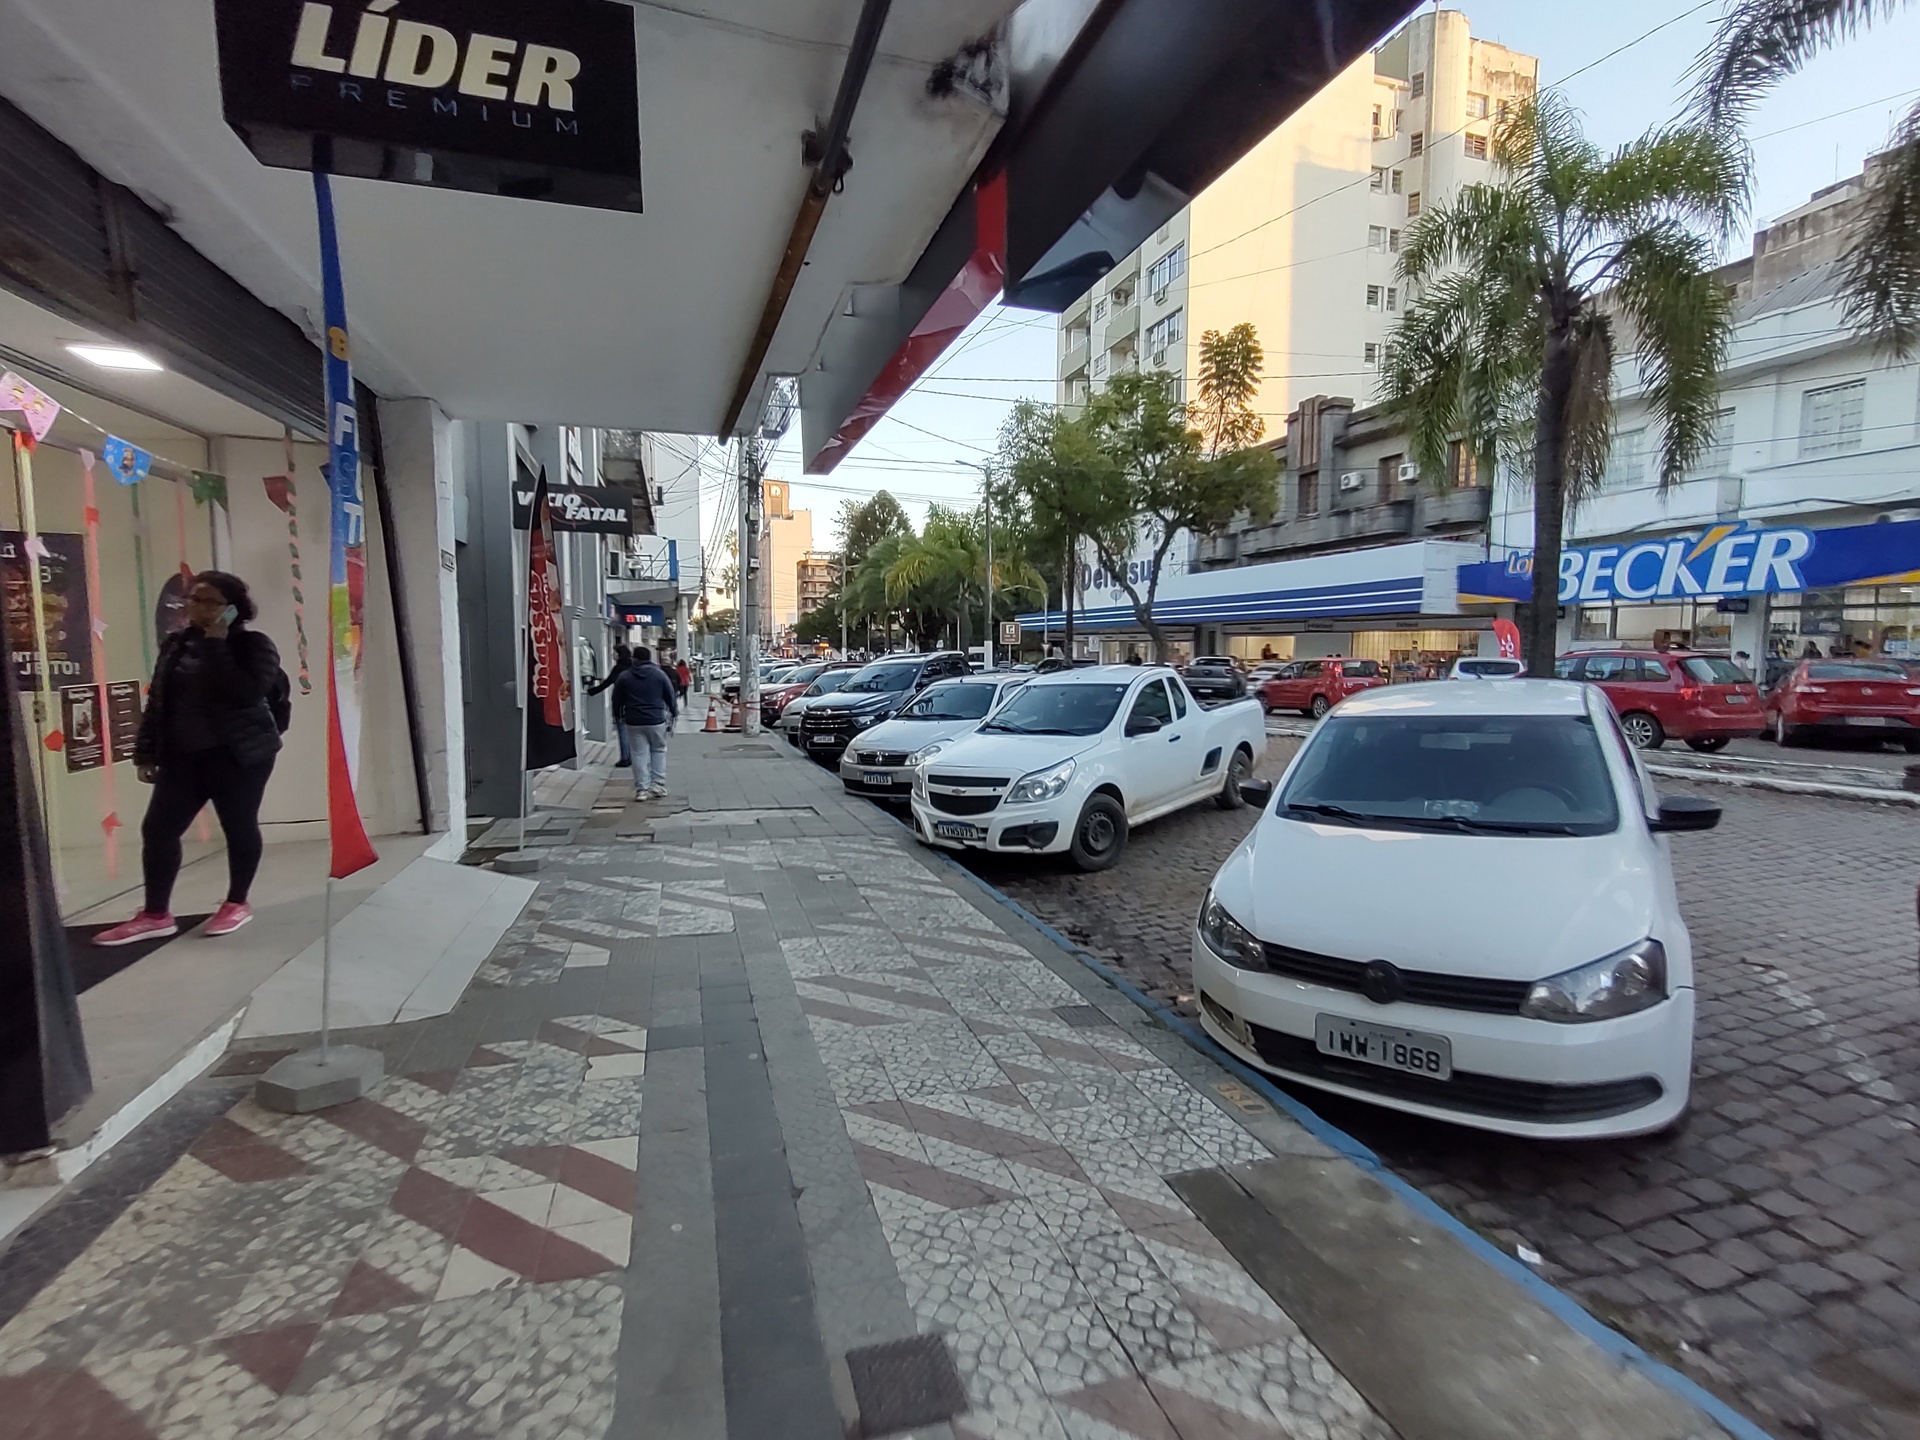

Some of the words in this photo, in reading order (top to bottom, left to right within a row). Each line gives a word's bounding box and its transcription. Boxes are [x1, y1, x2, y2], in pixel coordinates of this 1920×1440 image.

[290, 0, 581, 112] LÍDER
[290, 73, 579, 135] PREMIUM
[516, 490, 582, 508] VCIO
[565, 506, 628, 523] FATAL
[1559, 525, 1810, 601] BECKER
[636, 614, 652, 623] TIM
[19, 660, 81, 676] JETO!
